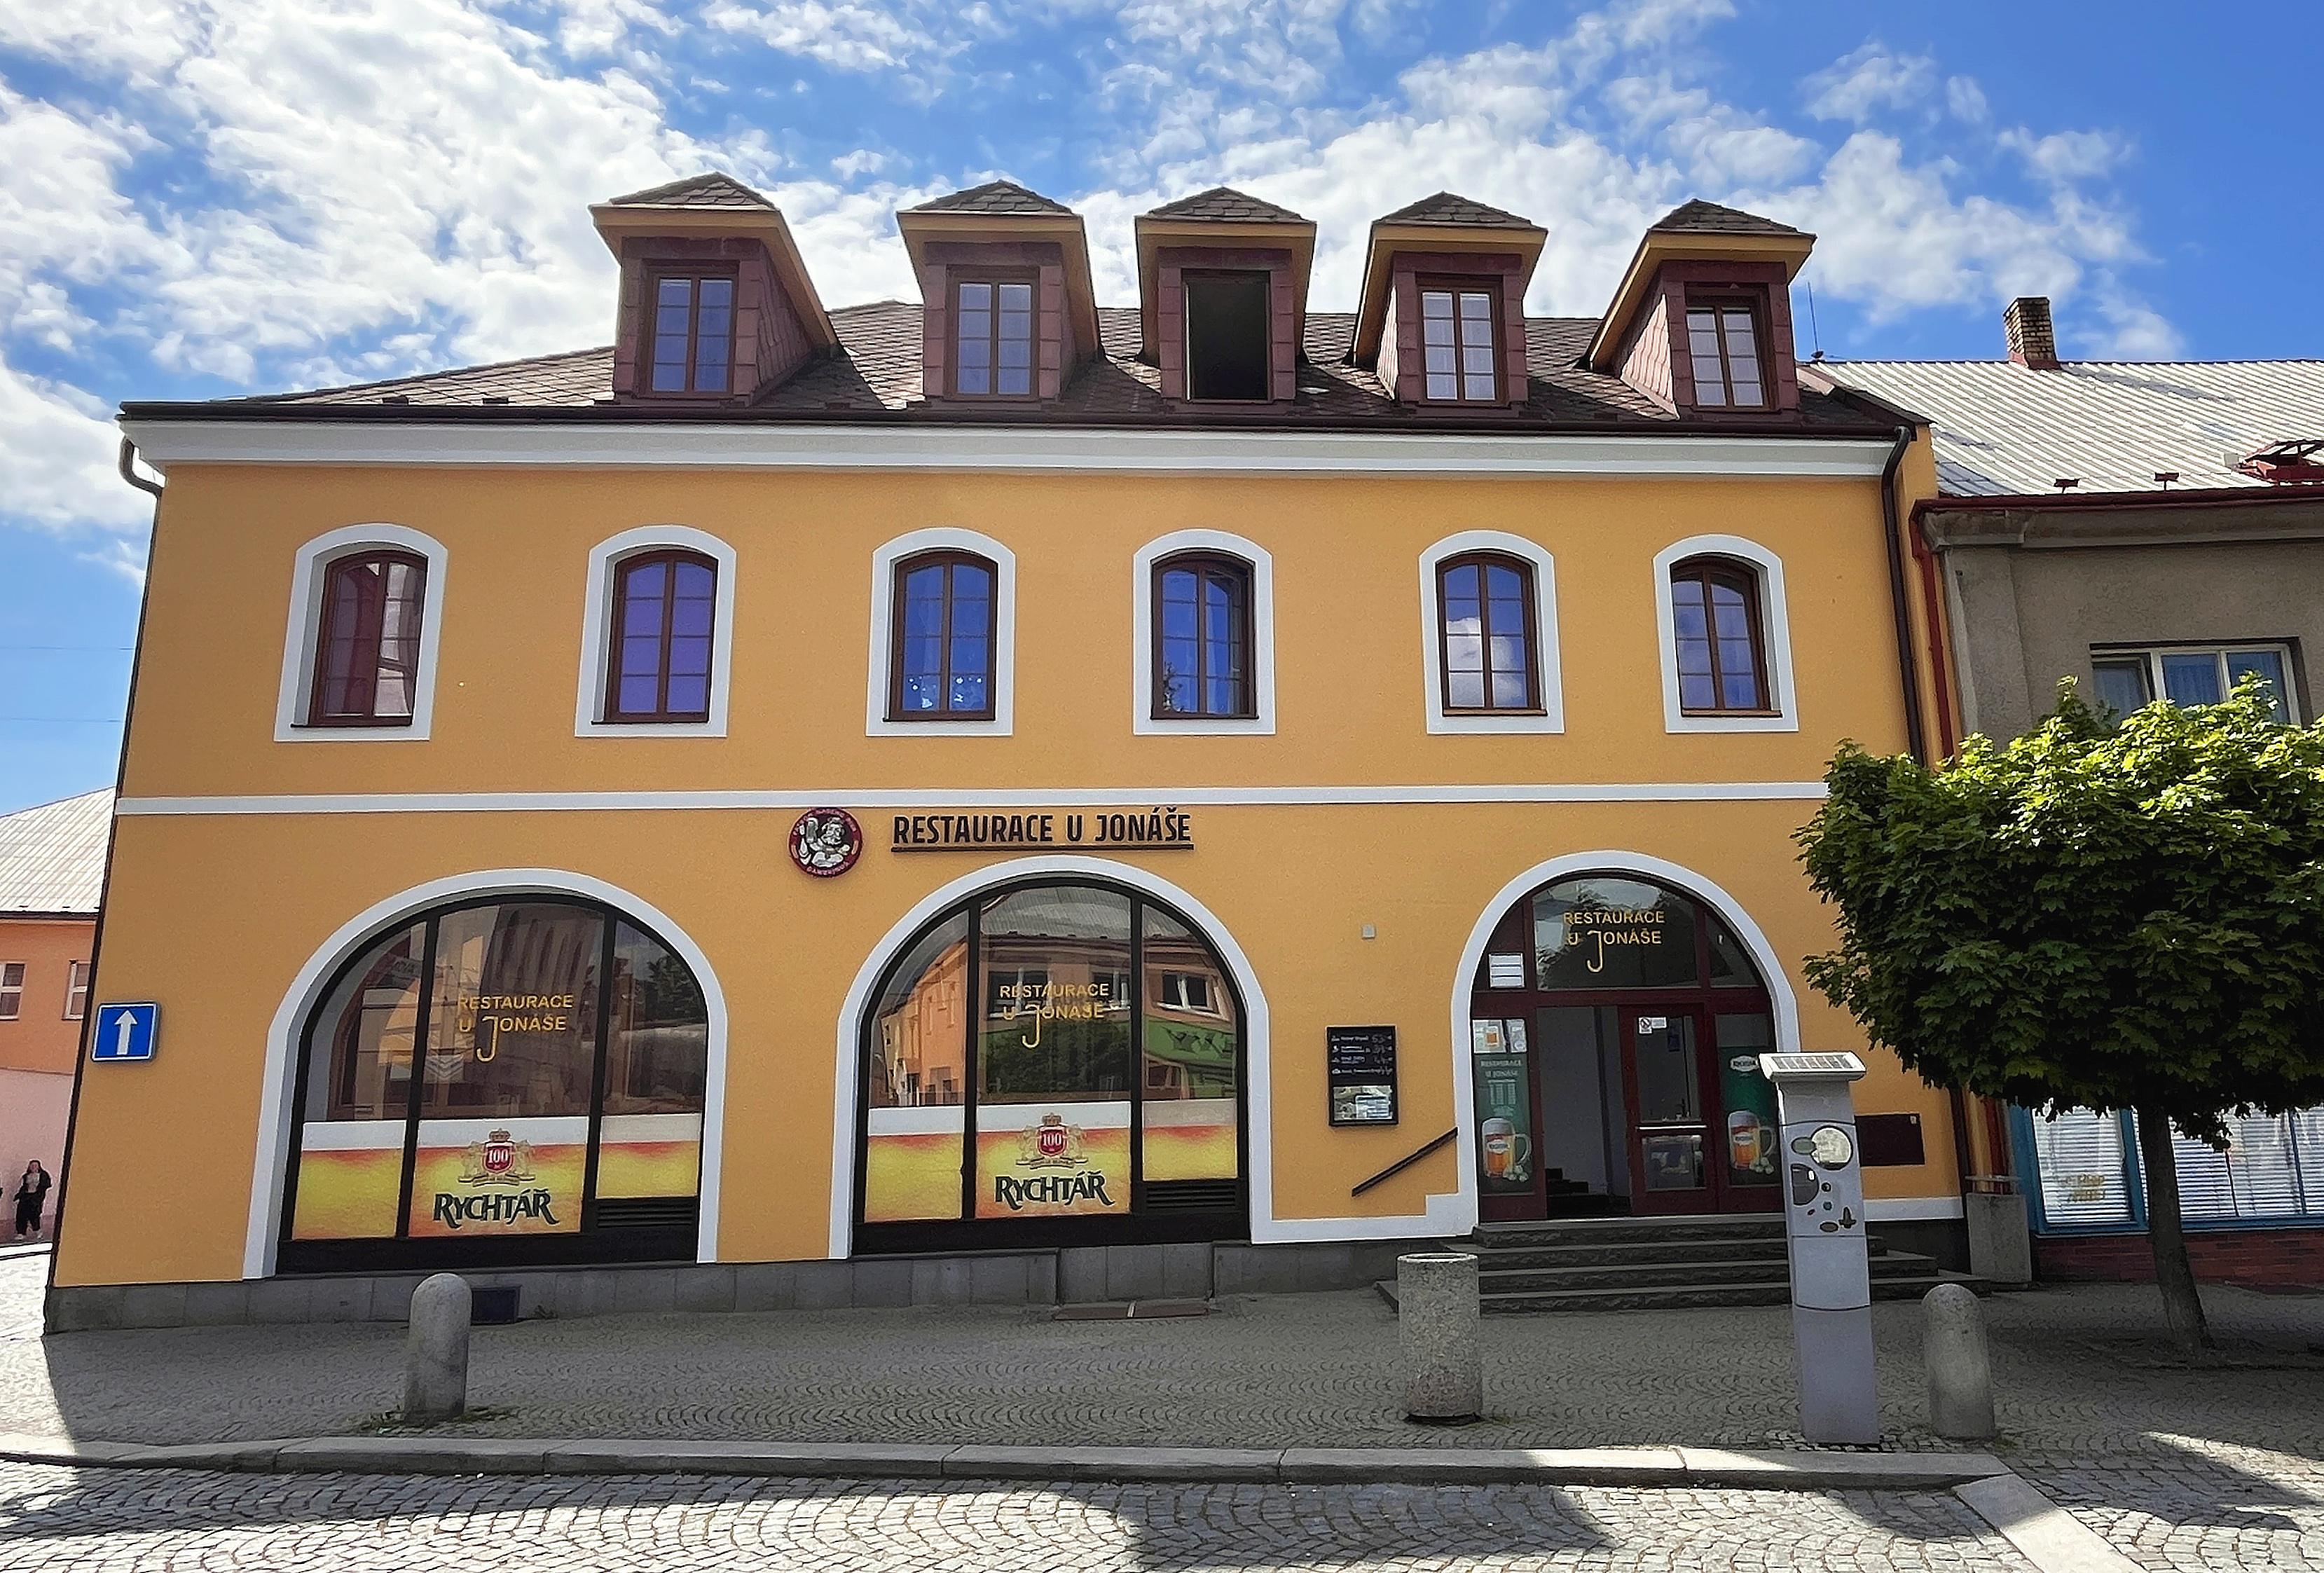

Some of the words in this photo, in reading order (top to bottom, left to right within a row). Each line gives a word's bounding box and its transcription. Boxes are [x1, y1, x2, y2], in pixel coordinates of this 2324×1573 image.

[893, 814, 1053, 844] RESTAURACE
[1067, 814, 1082, 842] U
[1095, 807, 1191, 842] JONÁŠE
[1563, 911, 1665, 925] RESTAURACE
[1587, 928, 1662, 973] JONÁŠE
[999, 983, 1109, 998] RESTAURACE
[458, 994, 574, 1010] RESTAURACE
[1003, 1006, 1015, 1020] U
[459, 1017, 472, 1032] U
[476, 1013, 567, 1062] JONÁŠE
[1043, 1134, 1062, 1146] 100
[488, 1148, 509, 1164] 100
[995, 1170, 1115, 1211] RYCHTÁŘ
[433, 1188, 561, 1229] RYCHTÁŘ
